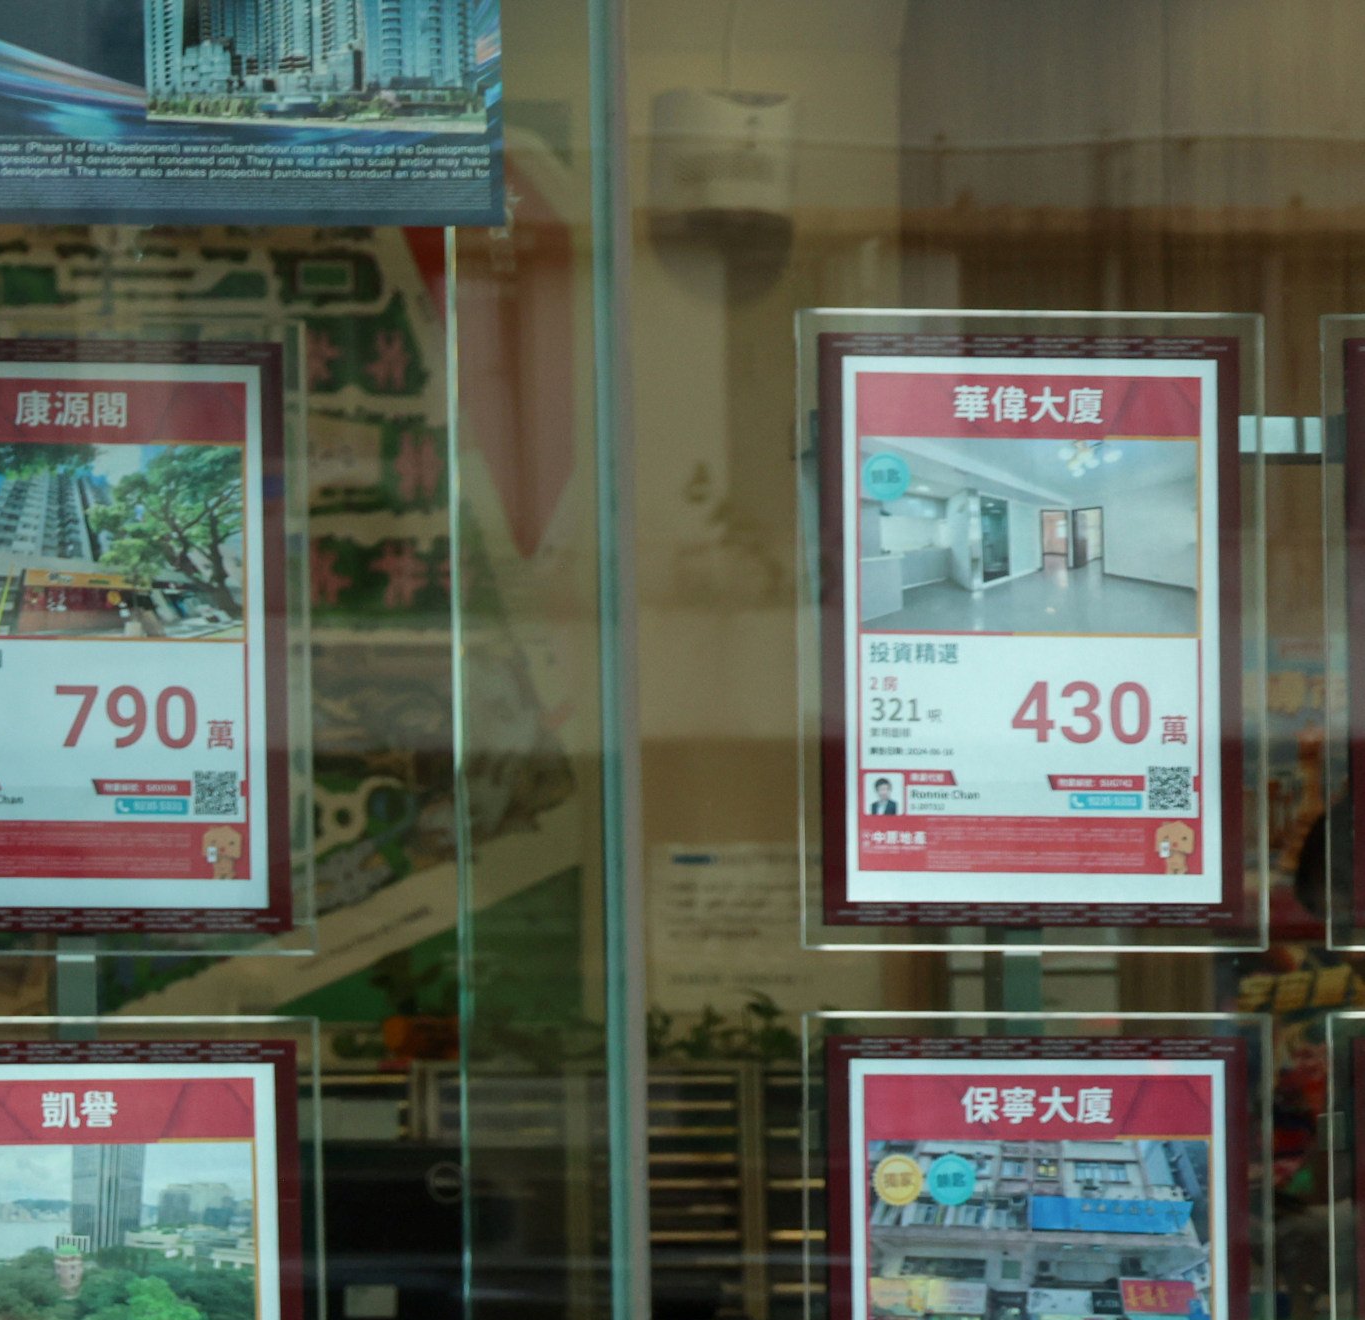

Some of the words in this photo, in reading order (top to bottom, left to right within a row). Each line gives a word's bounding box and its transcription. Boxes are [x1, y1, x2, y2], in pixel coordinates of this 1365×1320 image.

[16, 391, 127, 428] 康源閣
[953, 385, 1103, 424] 華偉大廈
[871, 642, 958, 664] 投資精選
[41, 1091, 117, 1128] 凱譽
